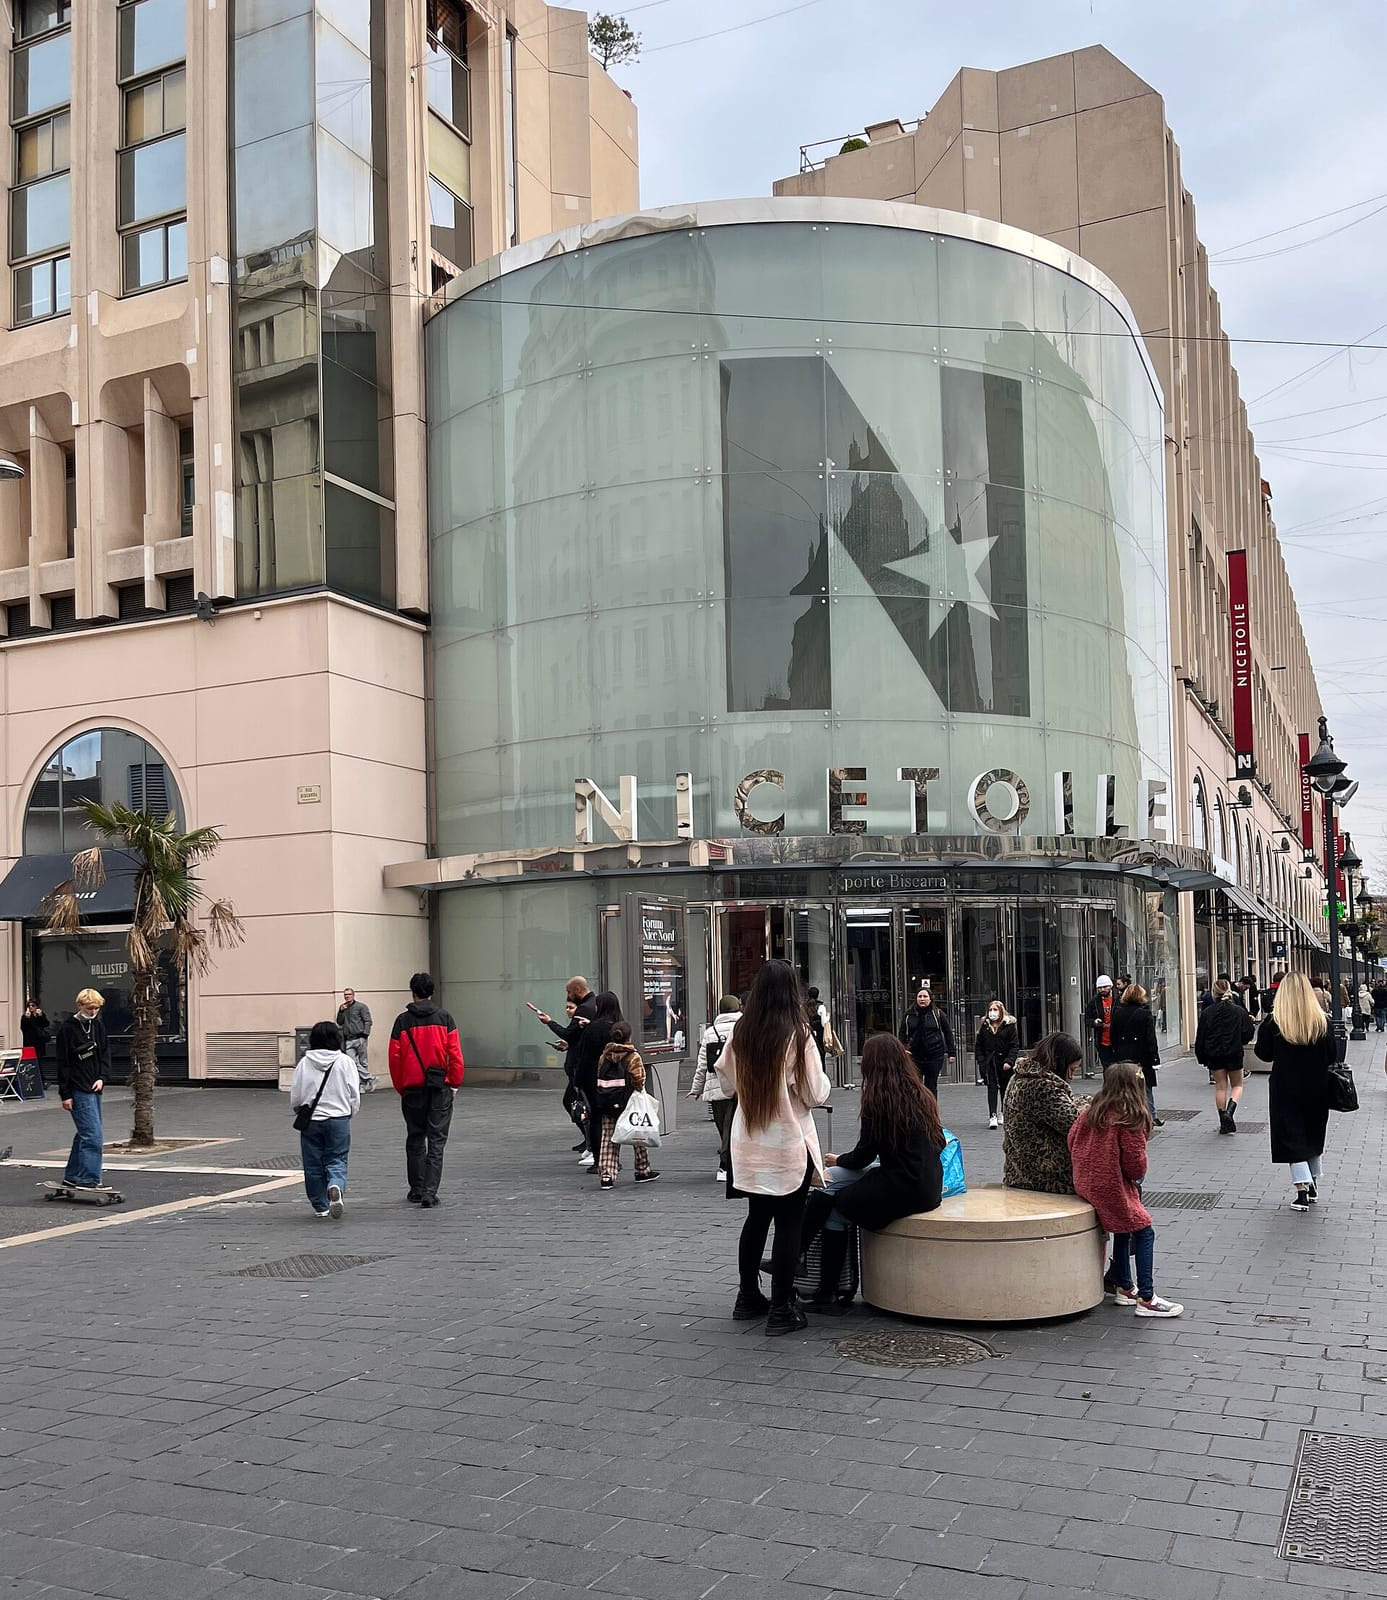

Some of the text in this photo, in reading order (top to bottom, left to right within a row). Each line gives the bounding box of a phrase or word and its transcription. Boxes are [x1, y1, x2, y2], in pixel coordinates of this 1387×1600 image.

[1234, 603, 1248, 688] NICETOILE
[1237, 754, 1252, 769] N
[574, 767, 1167, 842] NICETOILE
[844, 873, 947, 892] porte Biscarra
[642, 916, 664, 930] Forum
[642, 928, 675, 942] Nice Nord
[91, 962, 128, 975] HOLLISTER
